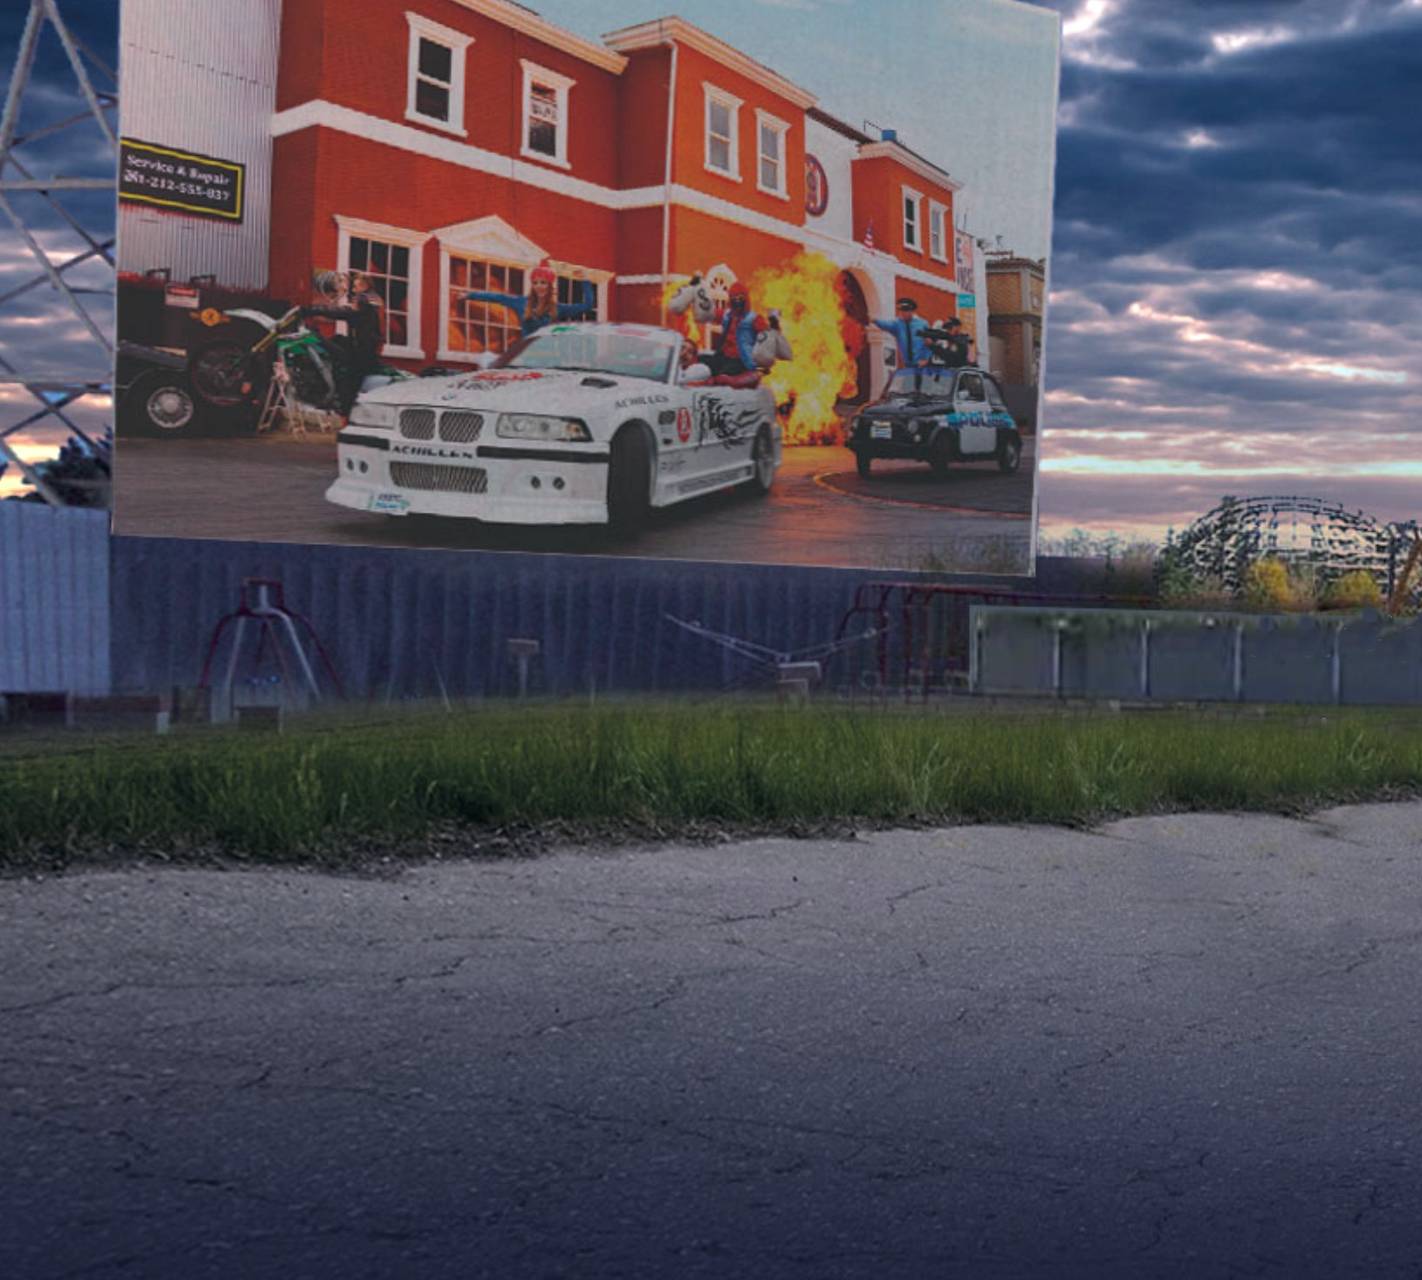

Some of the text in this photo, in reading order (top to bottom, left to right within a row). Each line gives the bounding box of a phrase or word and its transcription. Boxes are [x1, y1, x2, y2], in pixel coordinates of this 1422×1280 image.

[127, 155, 230, 186] Service & Repair
